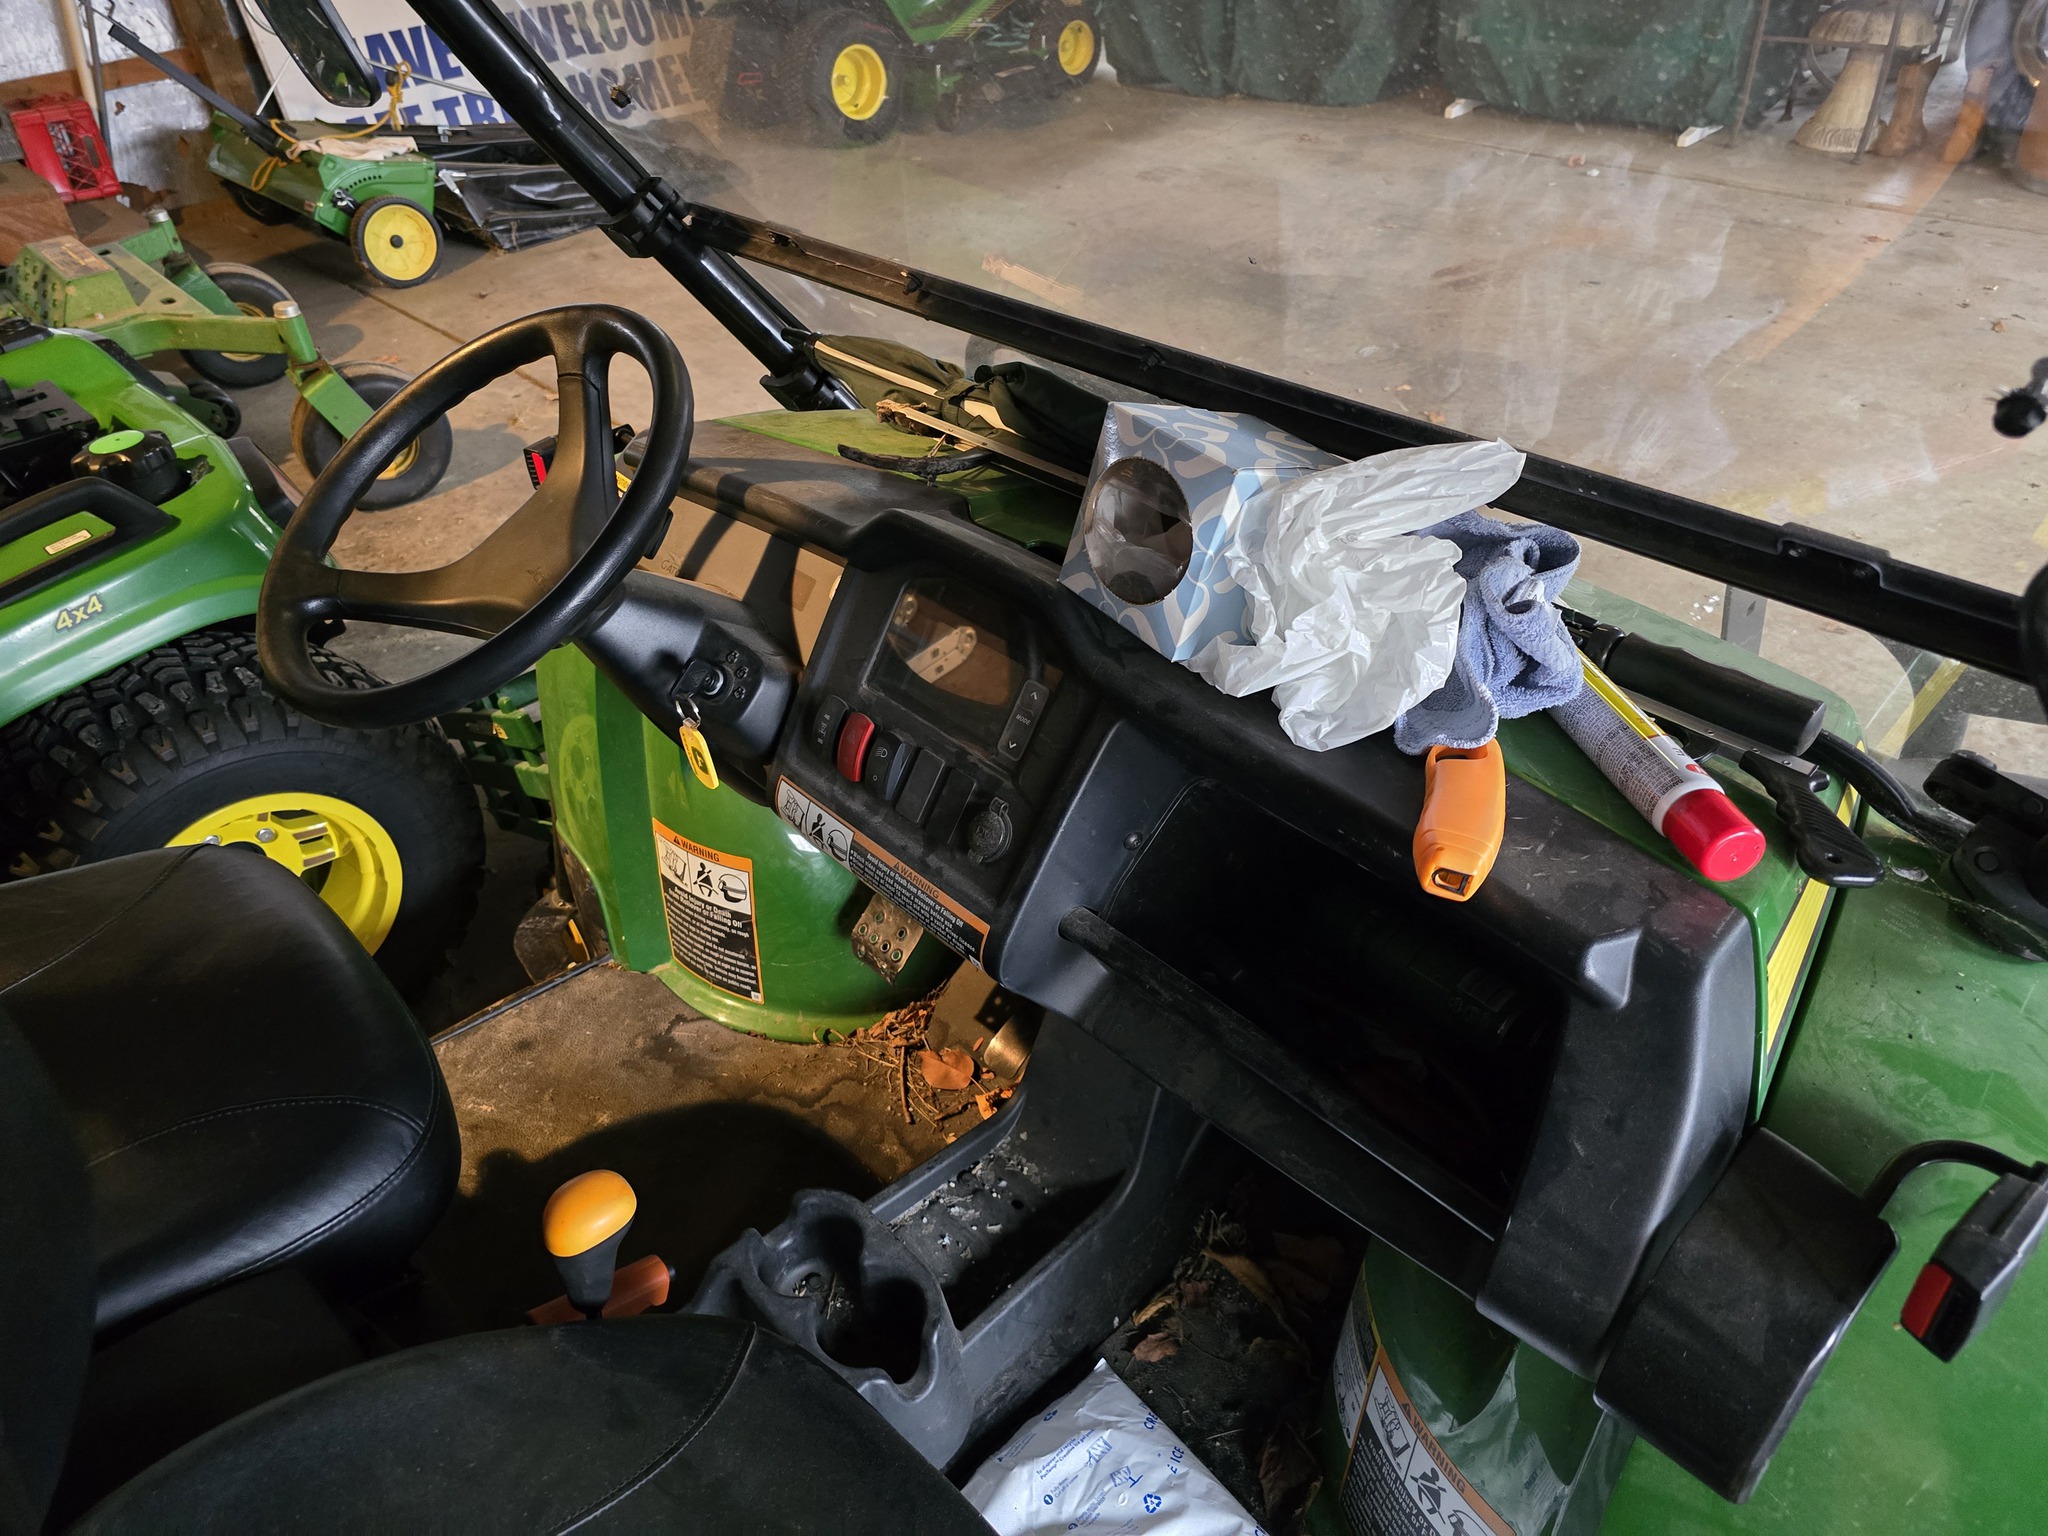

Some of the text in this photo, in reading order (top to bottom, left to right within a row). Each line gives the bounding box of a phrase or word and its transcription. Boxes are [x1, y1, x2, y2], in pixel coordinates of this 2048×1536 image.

[364, 24, 464, 92] AVE
[56, 594, 103, 631] 4x4
[1015, 713, 1031, 726] MODE
[681, 839, 720, 862] WARNING
[899, 866, 940, 899] WARNING
[705, 904, 712, 912] or
[917, 890, 936, 907] Rollover
[710, 911, 731, 926] Falling
[733, 919, 743, 928] Off
[1170, 1446, 1184, 1463] ICE
[1411, 1420, 1466, 1493] WARNING
[1368, 1439, 1420, 1527] from Rollover or
[1378, 1449, 1396, 1480] Avoid
[1396, 1480, 1418, 1514] Injury
[1418, 1515, 1428, 1528] or
